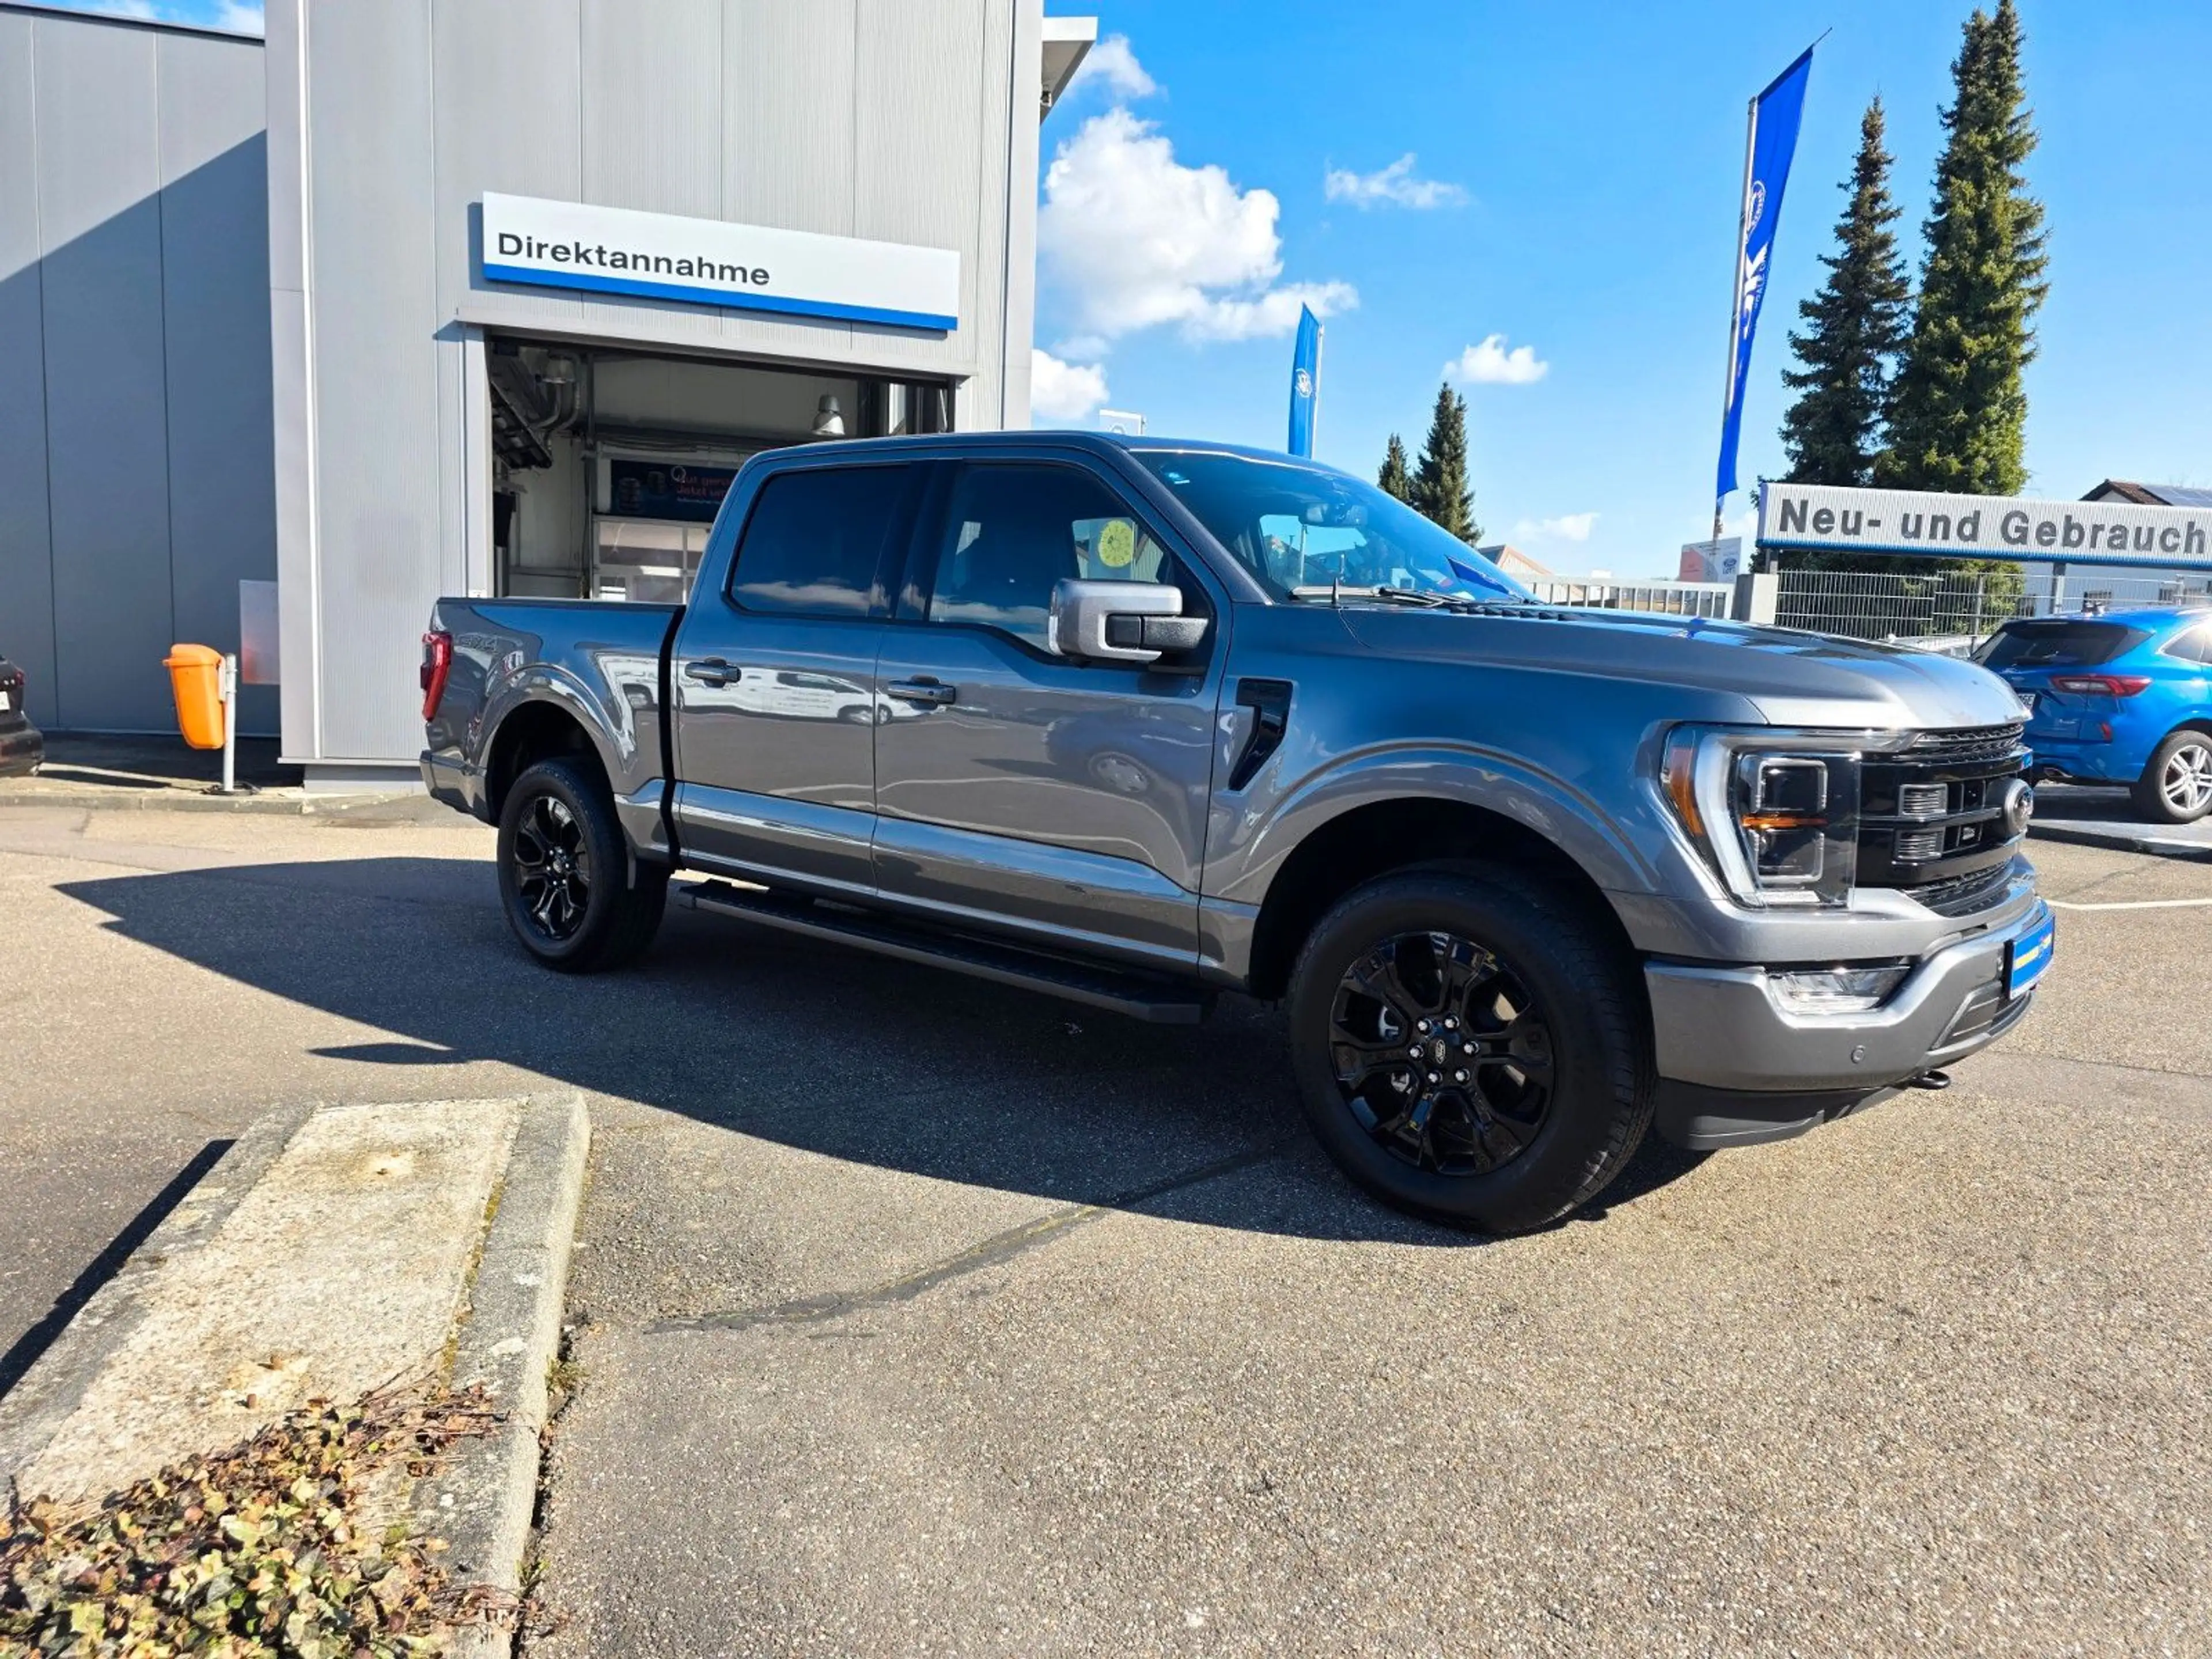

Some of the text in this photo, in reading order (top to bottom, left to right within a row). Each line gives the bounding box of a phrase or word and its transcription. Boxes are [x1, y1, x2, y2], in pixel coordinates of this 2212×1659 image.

[498, 232, 770, 286] Direktannahme
[1779, 498, 2206, 554] Neu- und Gebrauch
